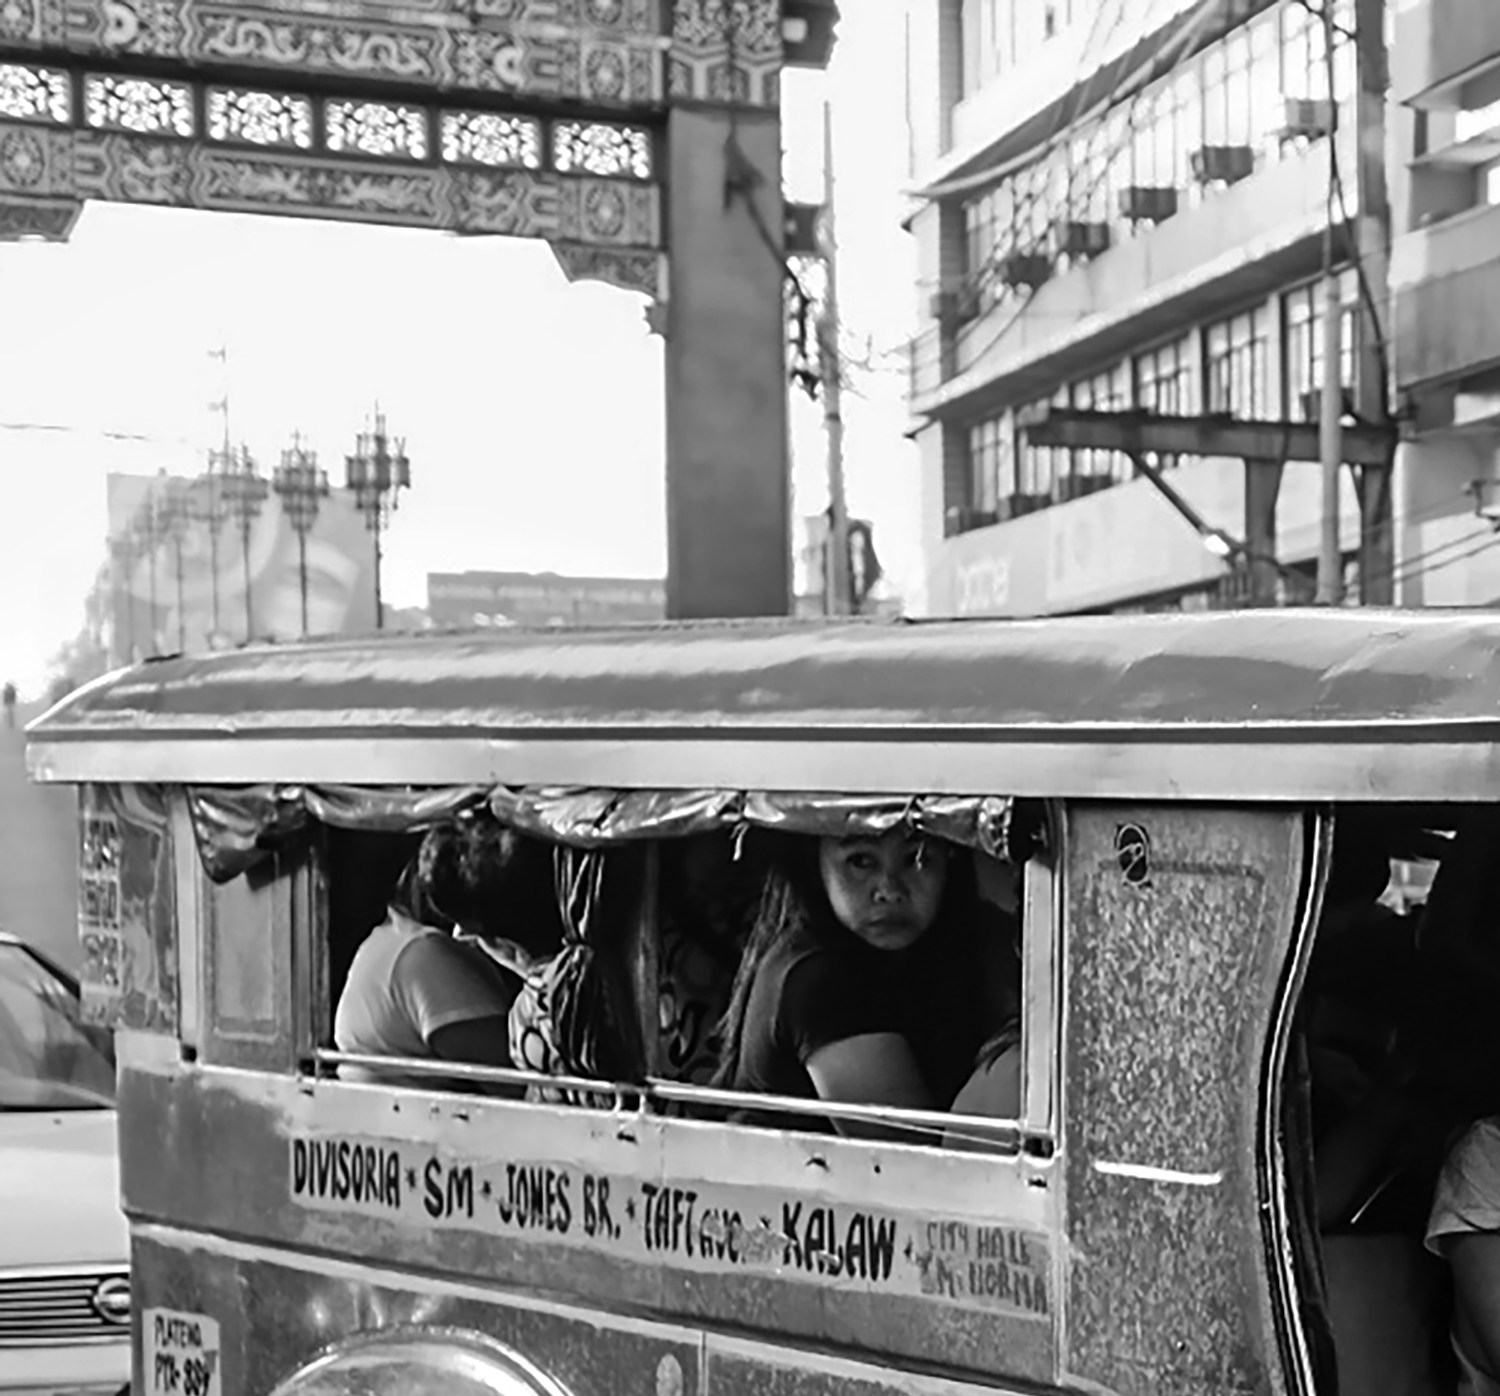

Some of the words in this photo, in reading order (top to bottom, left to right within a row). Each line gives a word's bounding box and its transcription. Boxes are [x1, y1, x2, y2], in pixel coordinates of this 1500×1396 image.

[294, 1138, 400, 1209] DIVISORIA
[423, 1157, 474, 1218] SM
[498, 1162, 572, 1234] JONES
[583, 1174, 621, 1240] BR.
[641, 1182, 697, 1257] TAFT
[783, 1201, 897, 1282] KALAW
